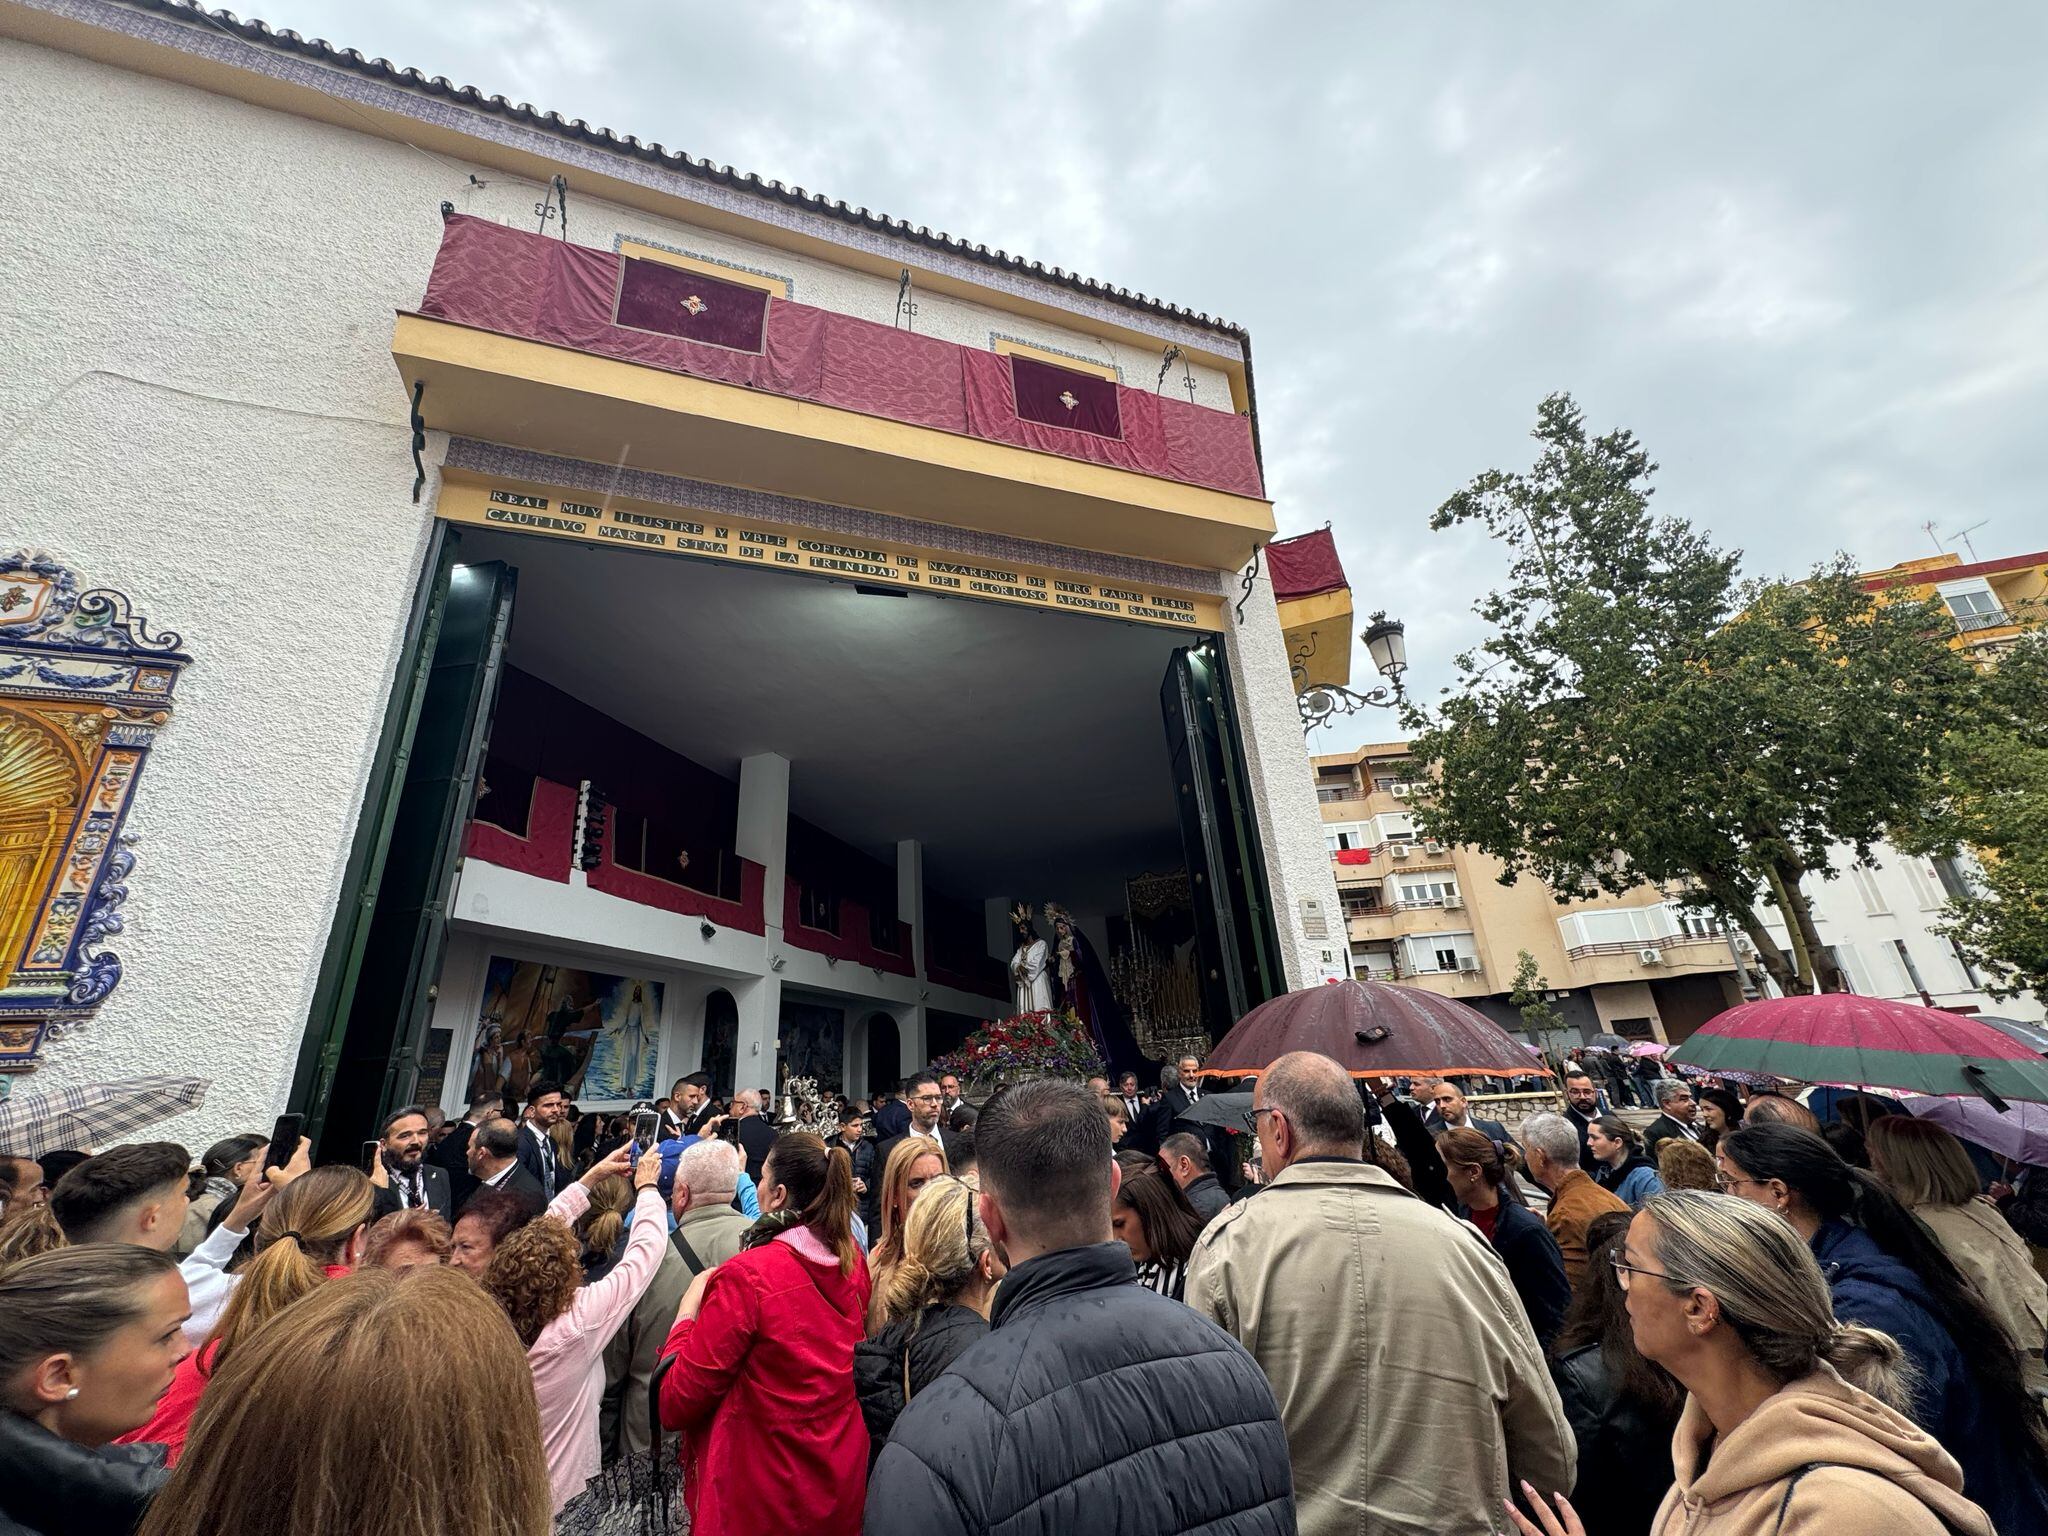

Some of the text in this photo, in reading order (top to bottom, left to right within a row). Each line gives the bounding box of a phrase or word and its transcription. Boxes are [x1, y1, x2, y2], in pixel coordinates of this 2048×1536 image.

[487, 510, 1196, 623] CAUTIVO MARIA STMA DE LA TRINIDAD Y DEL GLORIOSO APOSTOL SANTIAGO
[491, 491, 1193, 611] REAL MUY ILUSTRE Y VBLE COFRADIA DE NAZARENOS DE NTRO PADRE JESUS
[1323, 951, 1330, 961] 4
